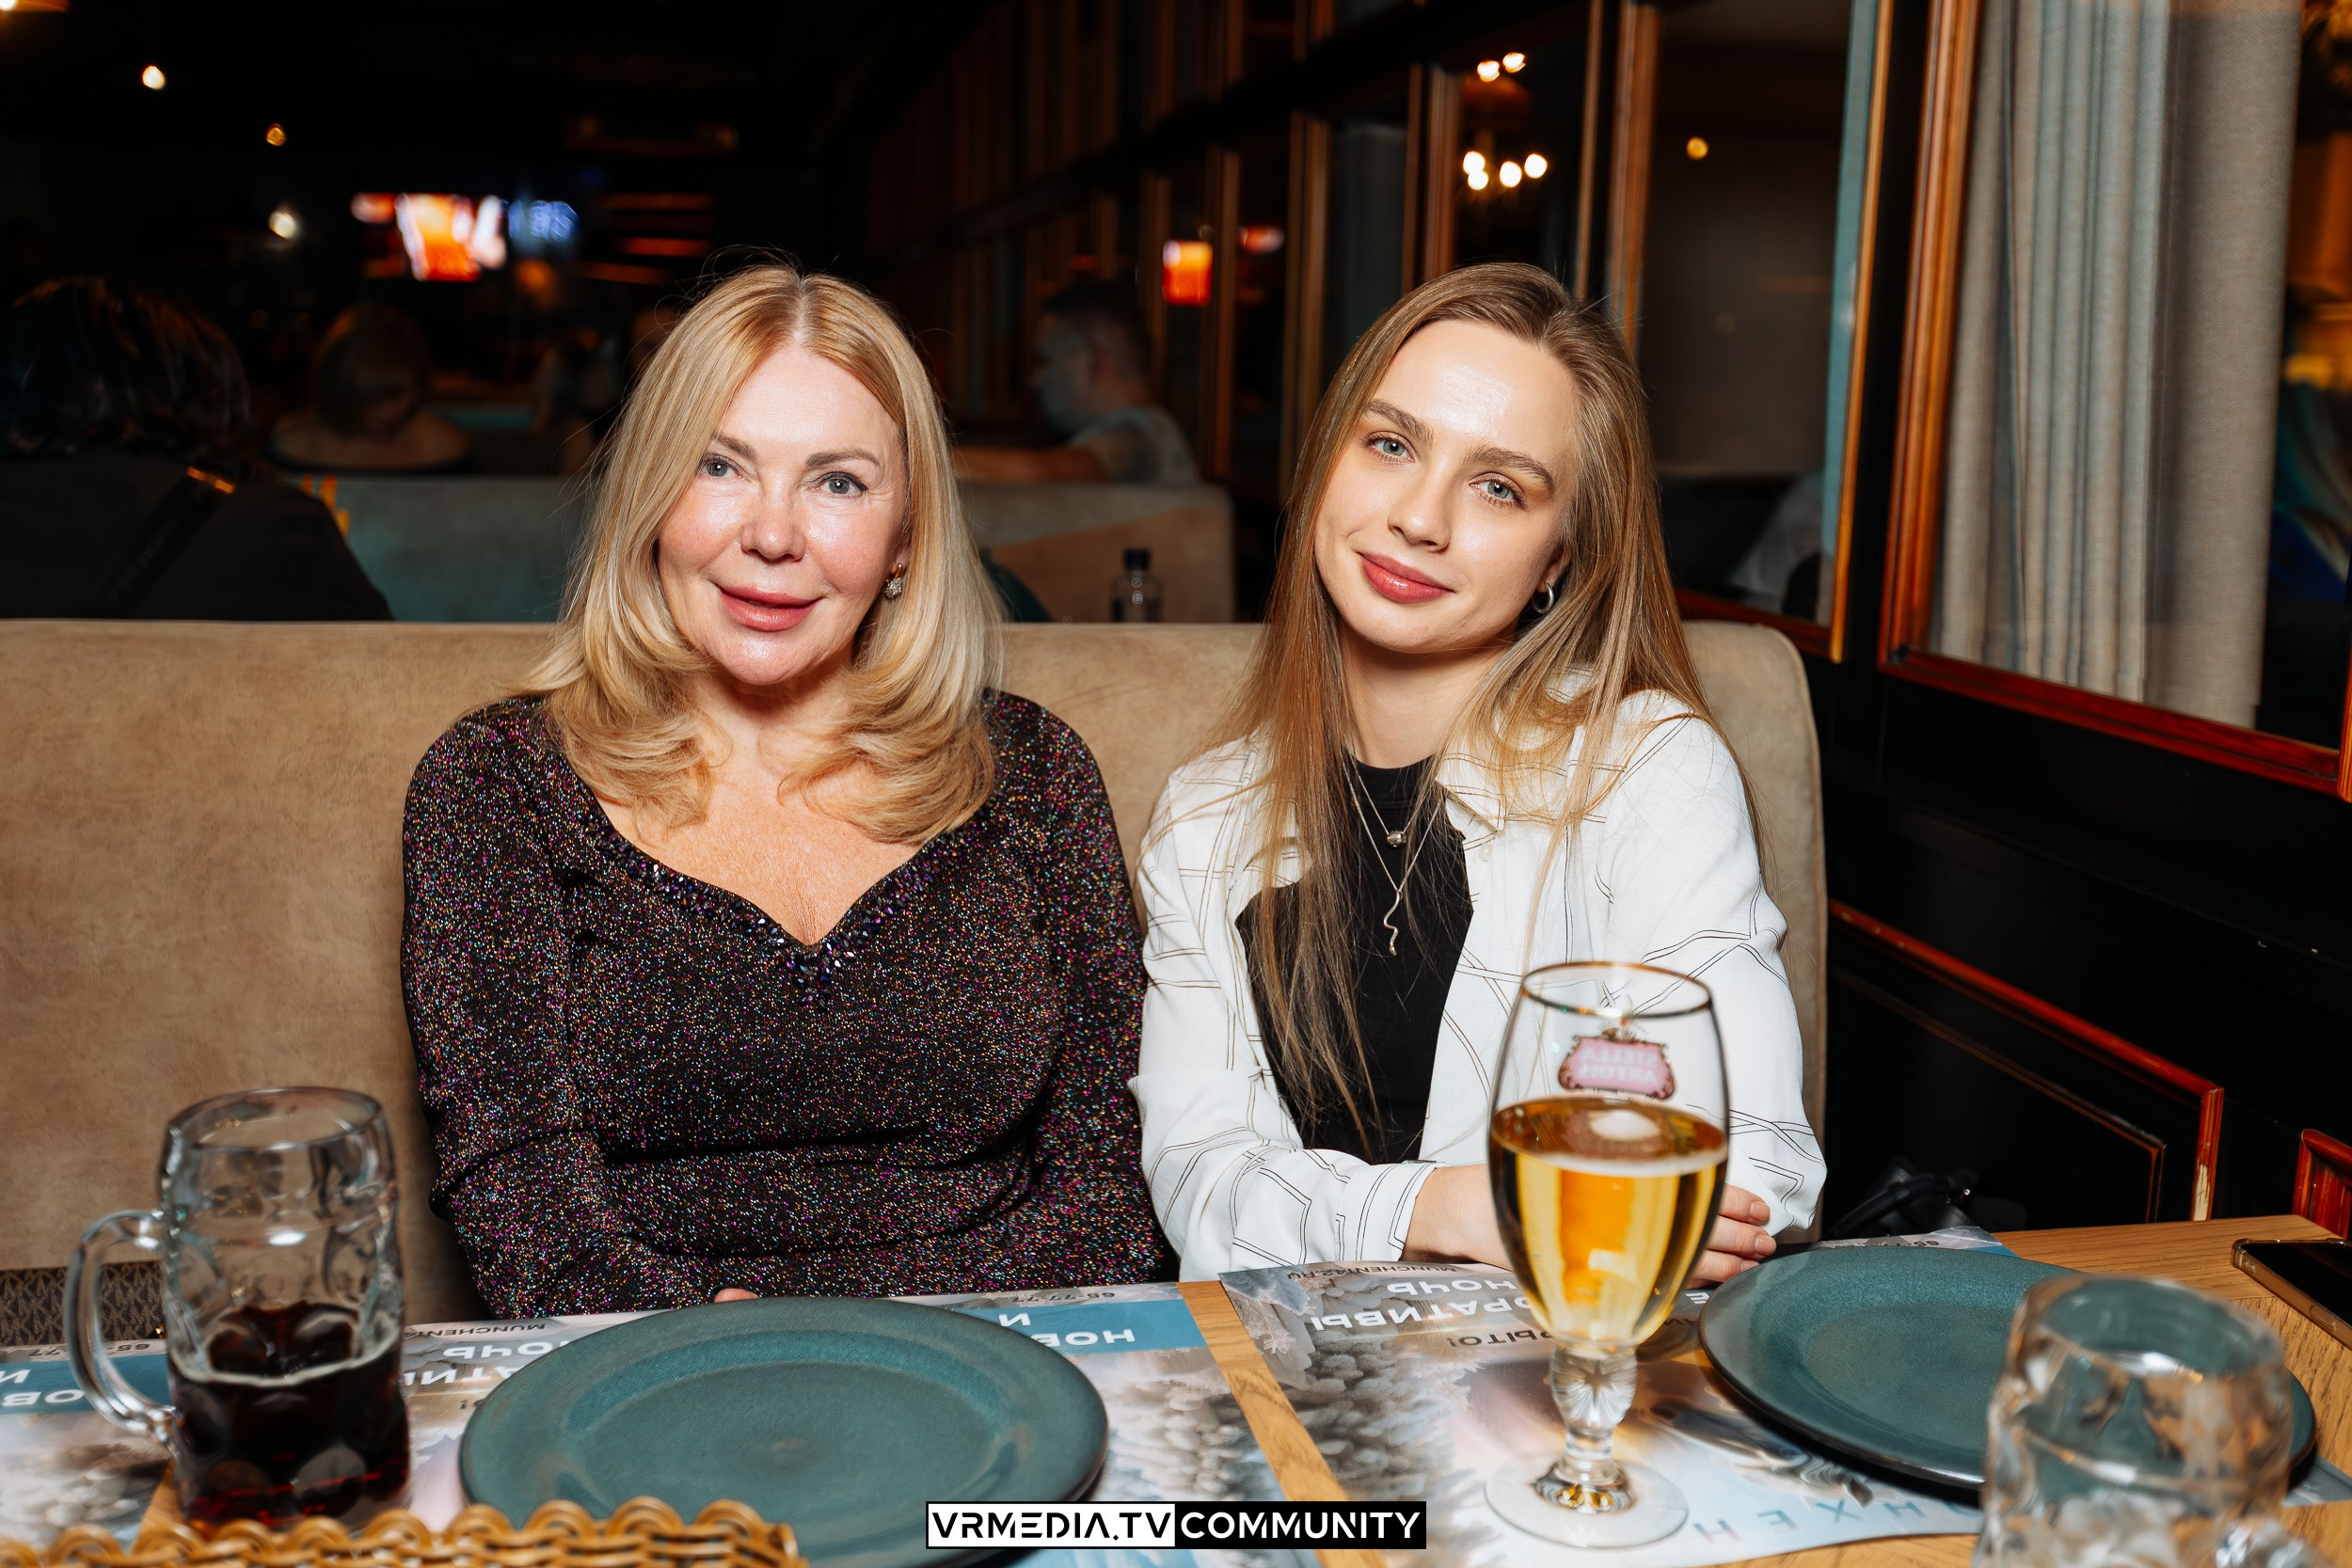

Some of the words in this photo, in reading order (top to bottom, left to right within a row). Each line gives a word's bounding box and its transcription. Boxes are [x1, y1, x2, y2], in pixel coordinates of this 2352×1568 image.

[1387, 1279, 1518, 1297] НОЧЬ
[1011, 1291, 1116, 1304] 65-77-77
[1310, 1295, 1533, 1332] ОРАТИВЫ
